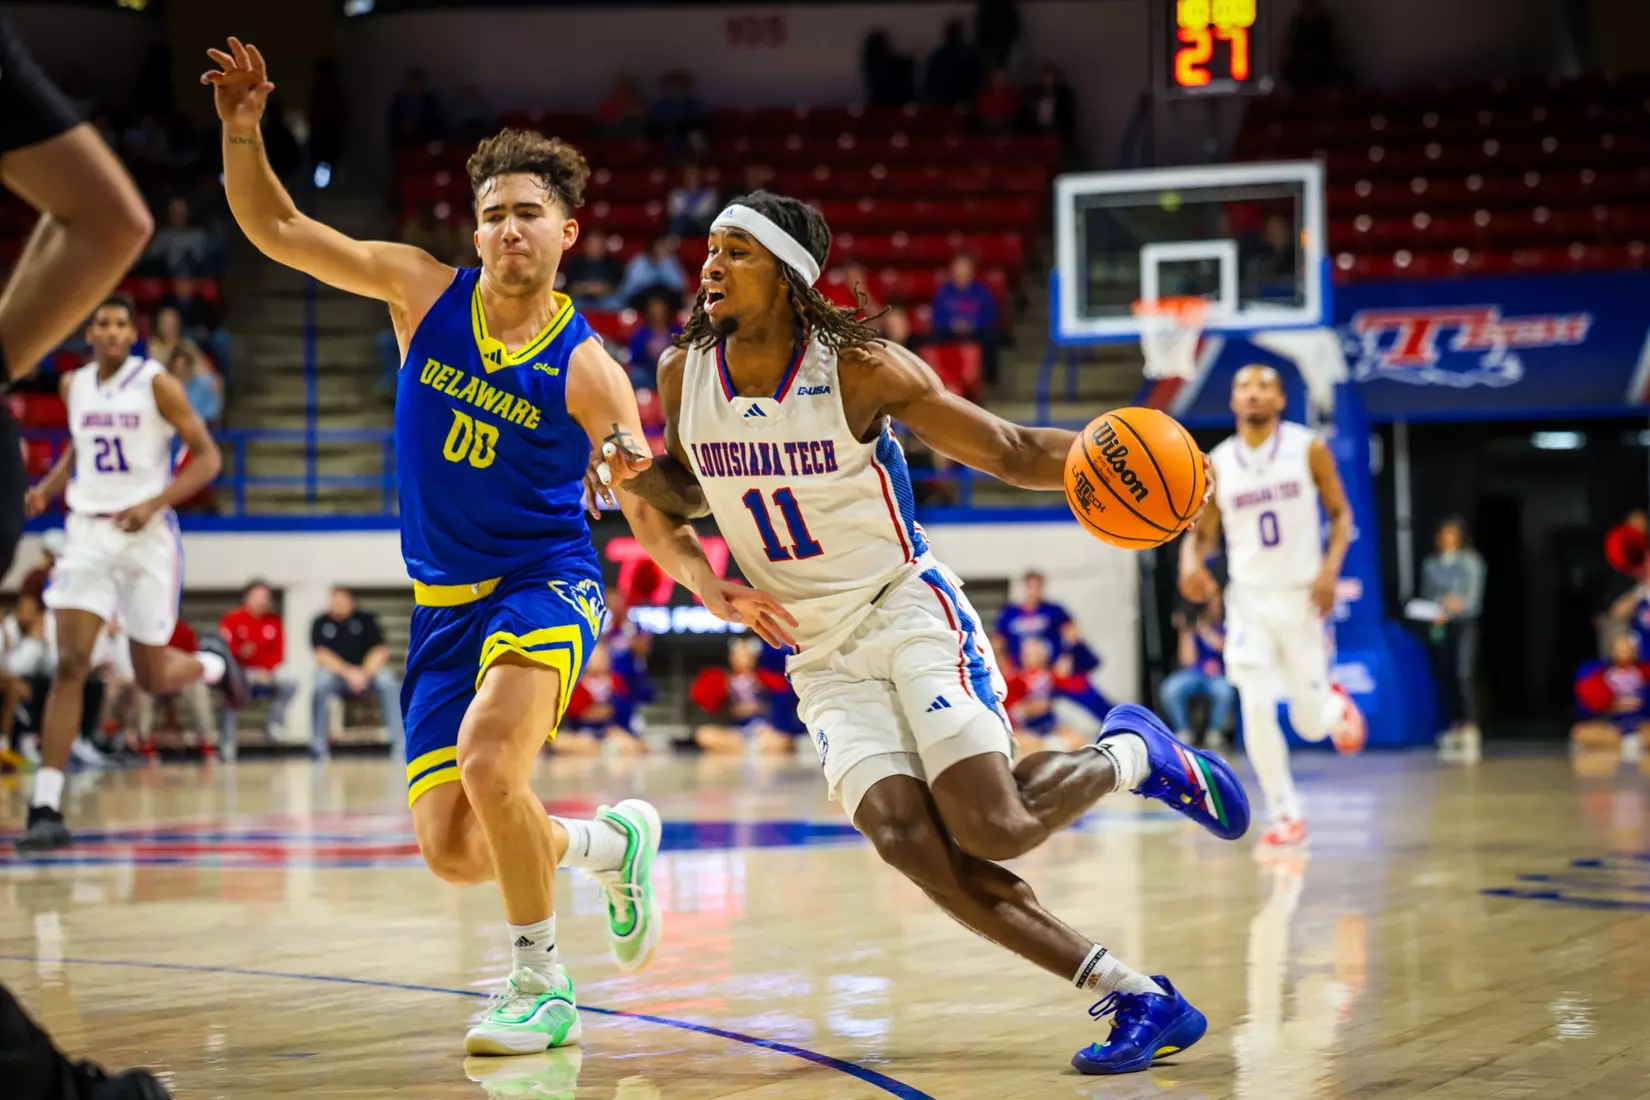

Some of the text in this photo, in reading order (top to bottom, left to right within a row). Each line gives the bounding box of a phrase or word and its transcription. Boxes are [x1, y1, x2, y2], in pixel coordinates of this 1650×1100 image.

[1174, 24, 1249, 87] 27
[420, 357, 542, 430] DELAWARE
[93, 436, 131, 473] 21
[442, 408, 499, 469] 00
[690, 439, 839, 478] LOUISIANA TECH
[1092, 420, 1149, 503] Wilson
[741, 486, 824, 562] 11
[1259, 510, 1280, 548] 0
